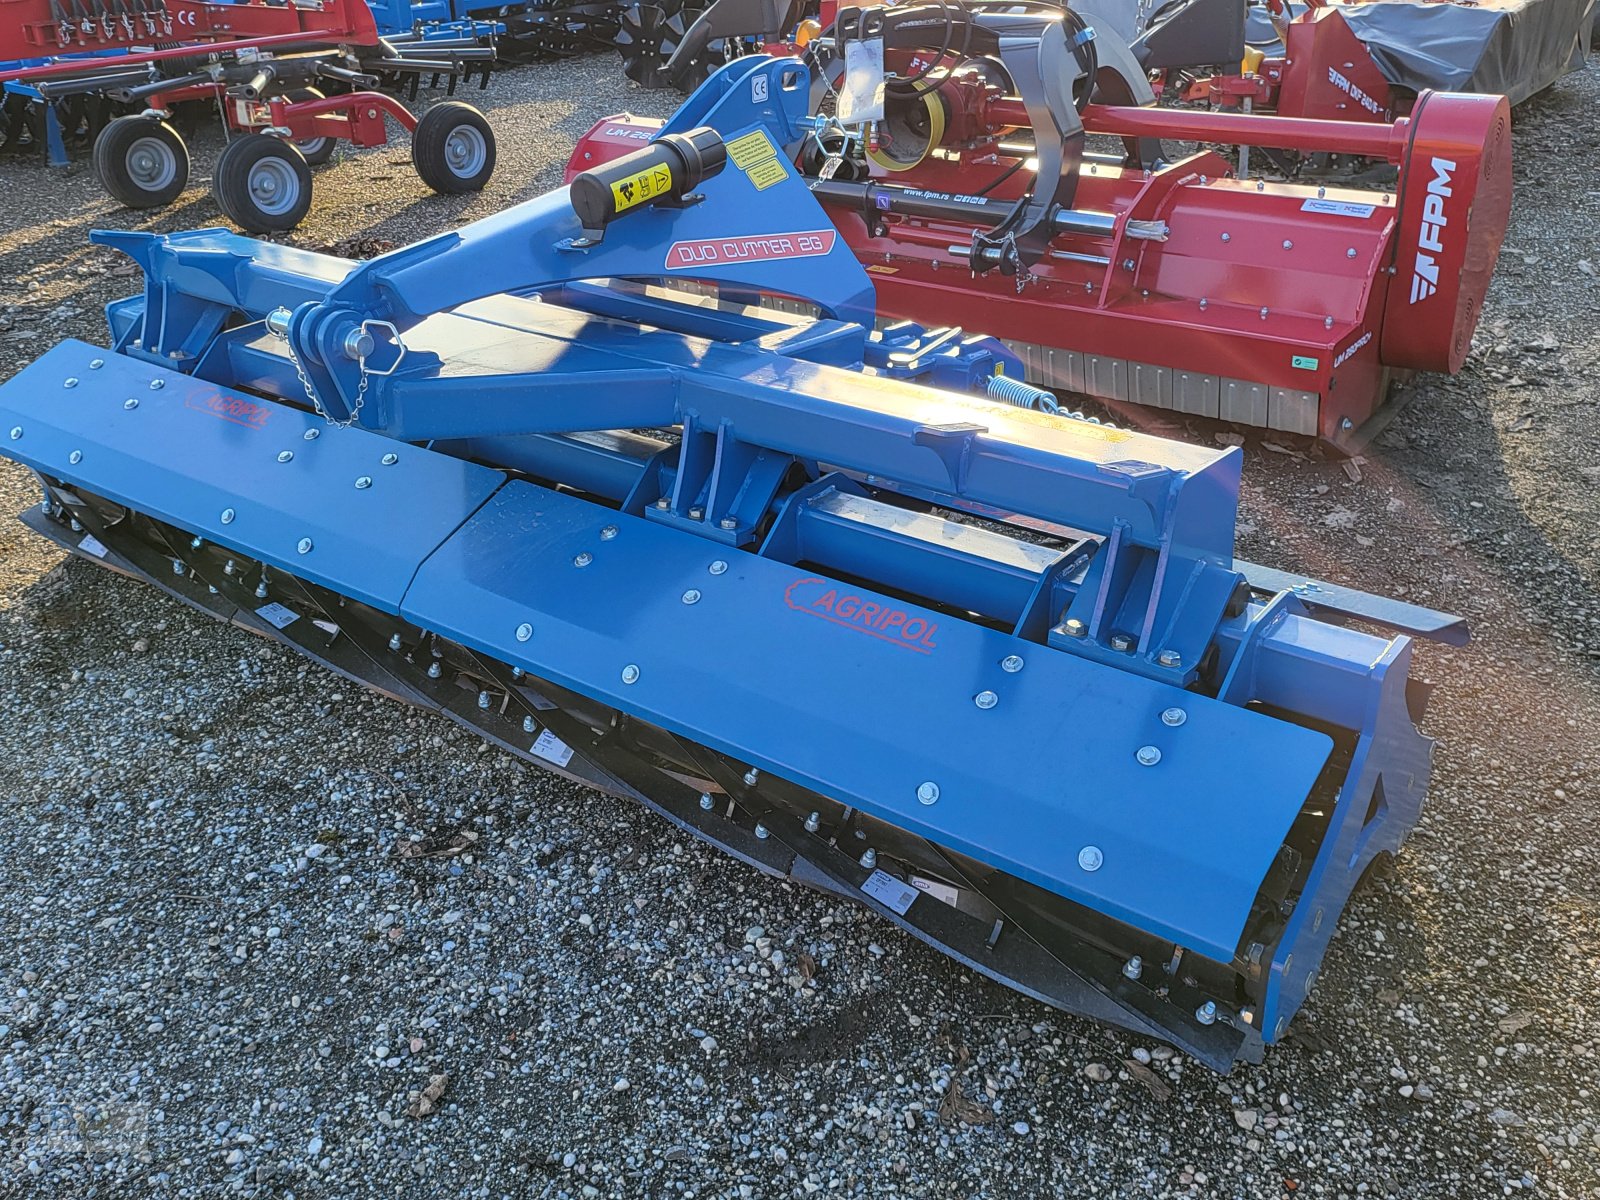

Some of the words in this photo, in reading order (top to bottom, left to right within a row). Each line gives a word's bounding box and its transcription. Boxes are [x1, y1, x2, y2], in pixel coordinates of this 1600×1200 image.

[177, 10, 196, 26] CE
[754, 80, 766, 96] CE
[903, 188, 950, 201] www.fpm.rs
[1418, 156, 1457, 253] FPM
[677, 245, 718, 263] DUO
[722, 239, 795, 259] CUTTER
[798, 236, 823, 251] 2G
[206, 393, 273, 426] AGRIPOL
[812, 589, 940, 649] AGRIPOL
